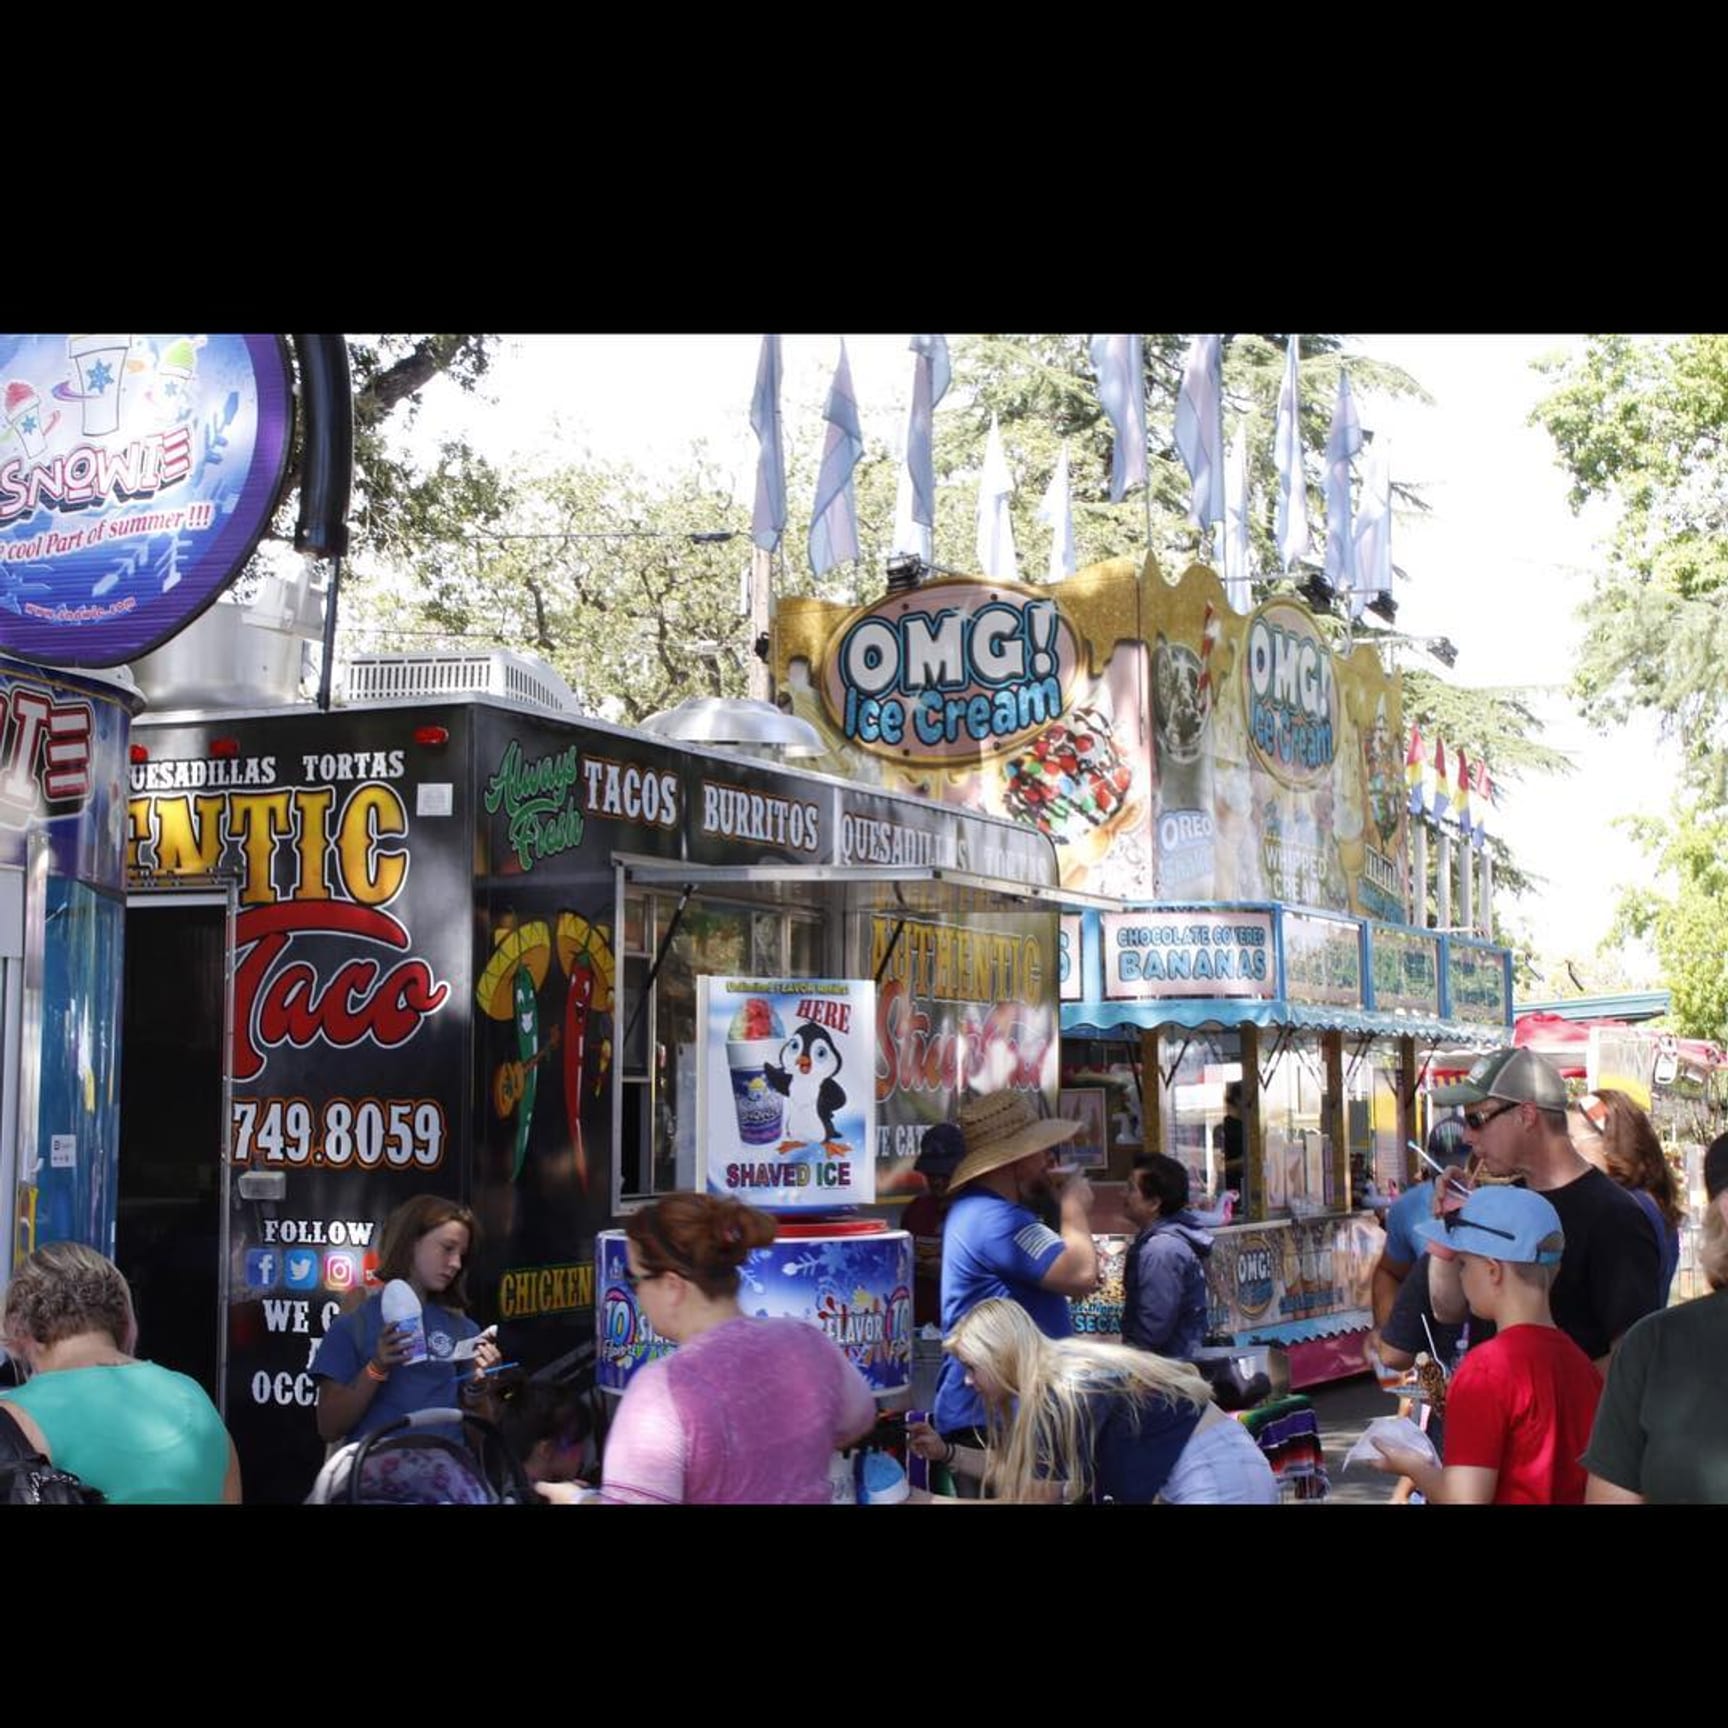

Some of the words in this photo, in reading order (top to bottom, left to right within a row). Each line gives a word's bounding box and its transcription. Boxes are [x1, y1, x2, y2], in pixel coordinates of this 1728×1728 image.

[0, 427, 193, 516] SNOWIE
[8, 537, 42, 560] cool
[46, 528, 83, 554] Part
[87, 520, 105, 545] of
[108, 512, 184, 538] summer
[840, 600, 1059, 698] OMG!
[844, 686, 906, 745] Ice
[911, 677, 1063, 745] Cream
[302, 750, 405, 781] TORTAS
[485, 740, 577, 816] Always
[584, 759, 677, 826] TACOS
[703, 786, 819, 850] BURRITOS
[1117, 926, 1209, 948] CHOCOLATE
[1119, 950, 1266, 981] BANANAS
[796, 999, 851, 1034] HERE
[727, 1163, 810, 1188] SHAVED
[817, 1162, 850, 1186] ICE
[263, 1220, 373, 1245] FOLLOW
[501, 1265, 593, 1316] CHICKEN
[262, 1300, 309, 1333] WE
